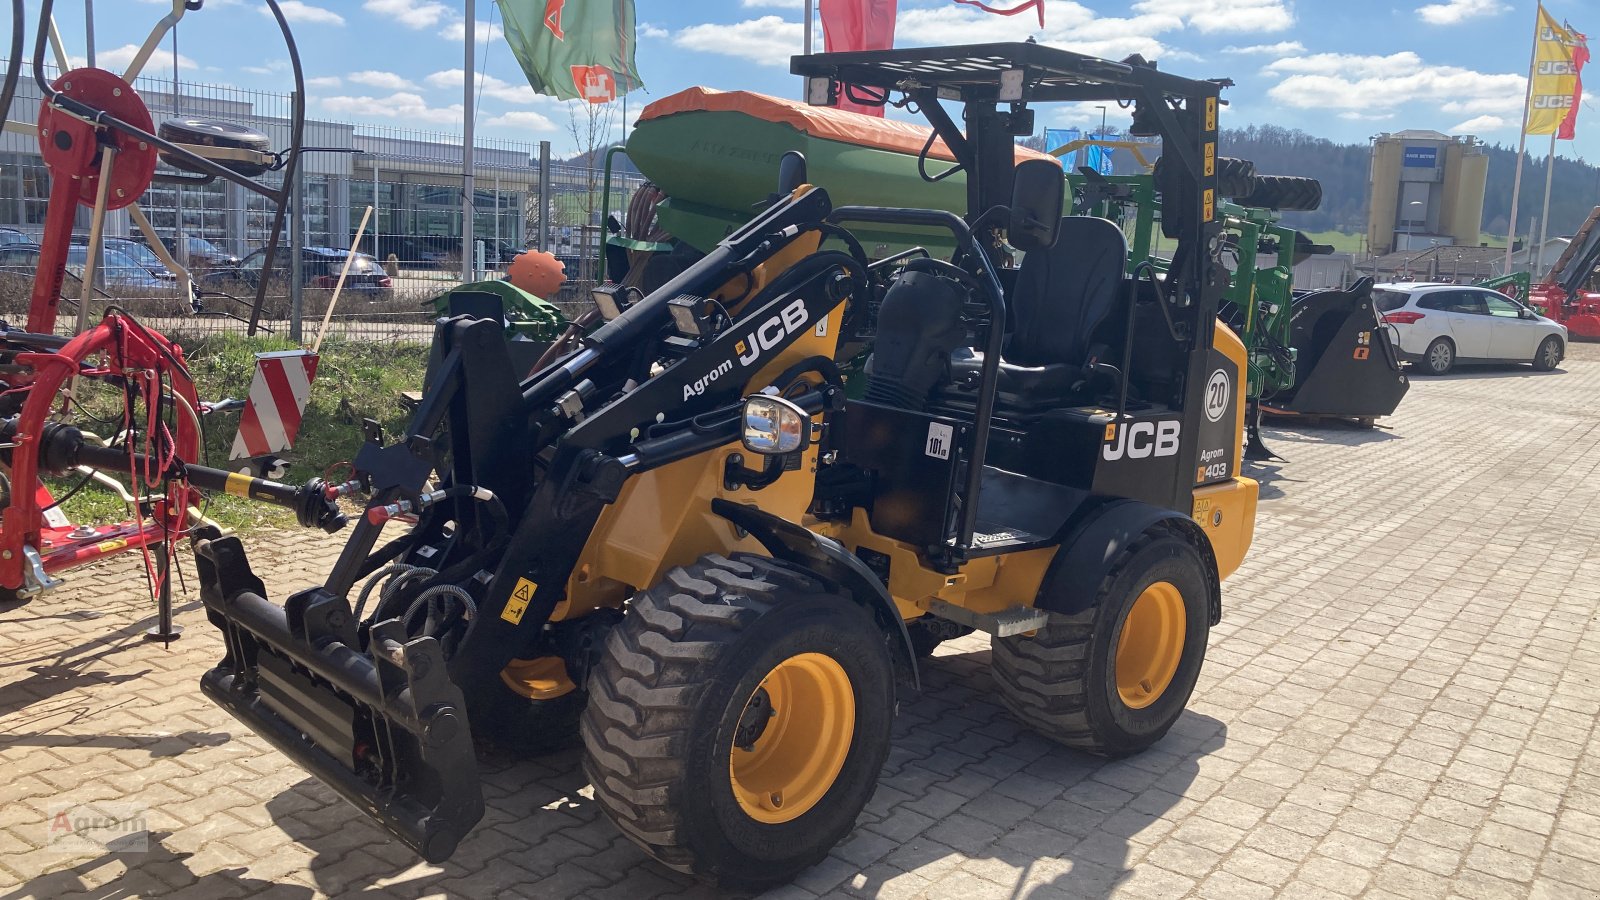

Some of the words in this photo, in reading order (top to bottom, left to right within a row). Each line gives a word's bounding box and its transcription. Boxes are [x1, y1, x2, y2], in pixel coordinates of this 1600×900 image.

[683, 359, 733, 401] Agrom
[739, 298, 809, 367] JCB
[1208, 382, 1226, 409] 20
[930, 437, 942, 455] 101
[1103, 420, 1181, 461] JCB
[1200, 448, 1224, 461] Agrom
[1205, 462, 1227, 478] 403
